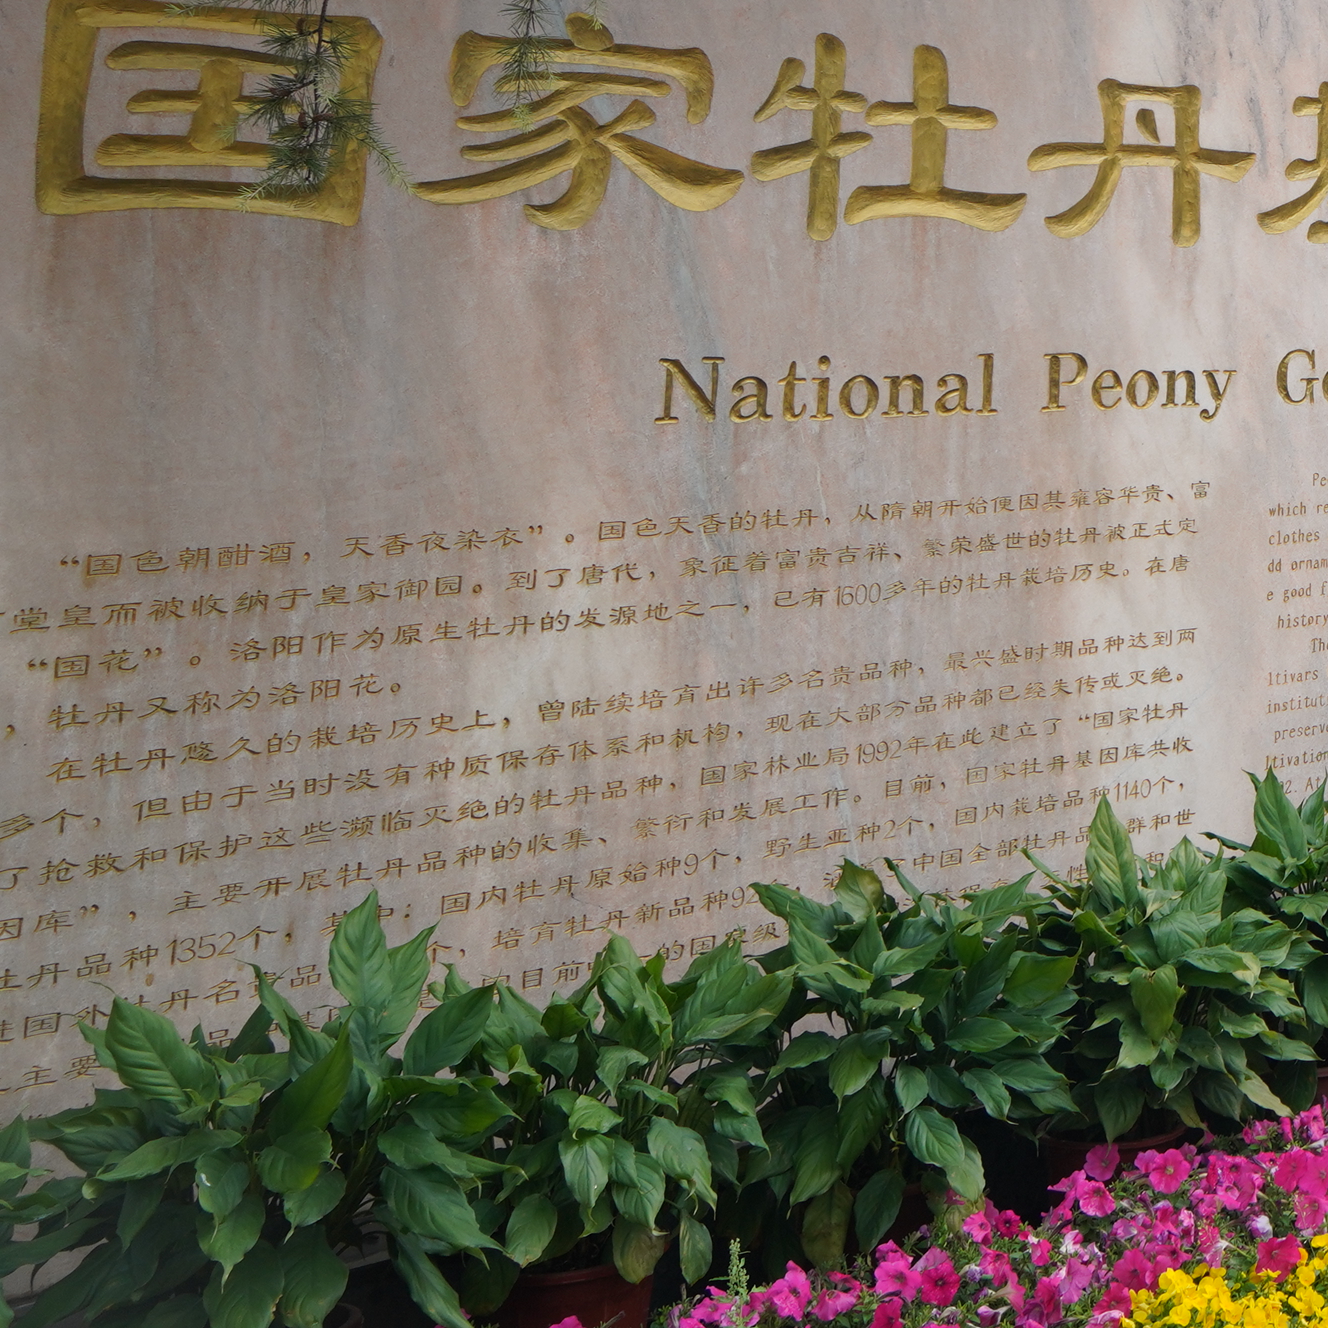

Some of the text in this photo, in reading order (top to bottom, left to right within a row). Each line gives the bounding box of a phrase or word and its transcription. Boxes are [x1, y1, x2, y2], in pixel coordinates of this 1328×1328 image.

[654, 353, 998, 425] National
[1041, 351, 1237, 423] Peony
[1268, 502, 1307, 517] which
[1268, 529, 1320, 546] clothes
[1267, 558, 1282, 573] dd
[1283, 583, 1312, 603] good
[1277, 614, 1328, 629] history
[1268, 669, 1319, 687] ltivars
